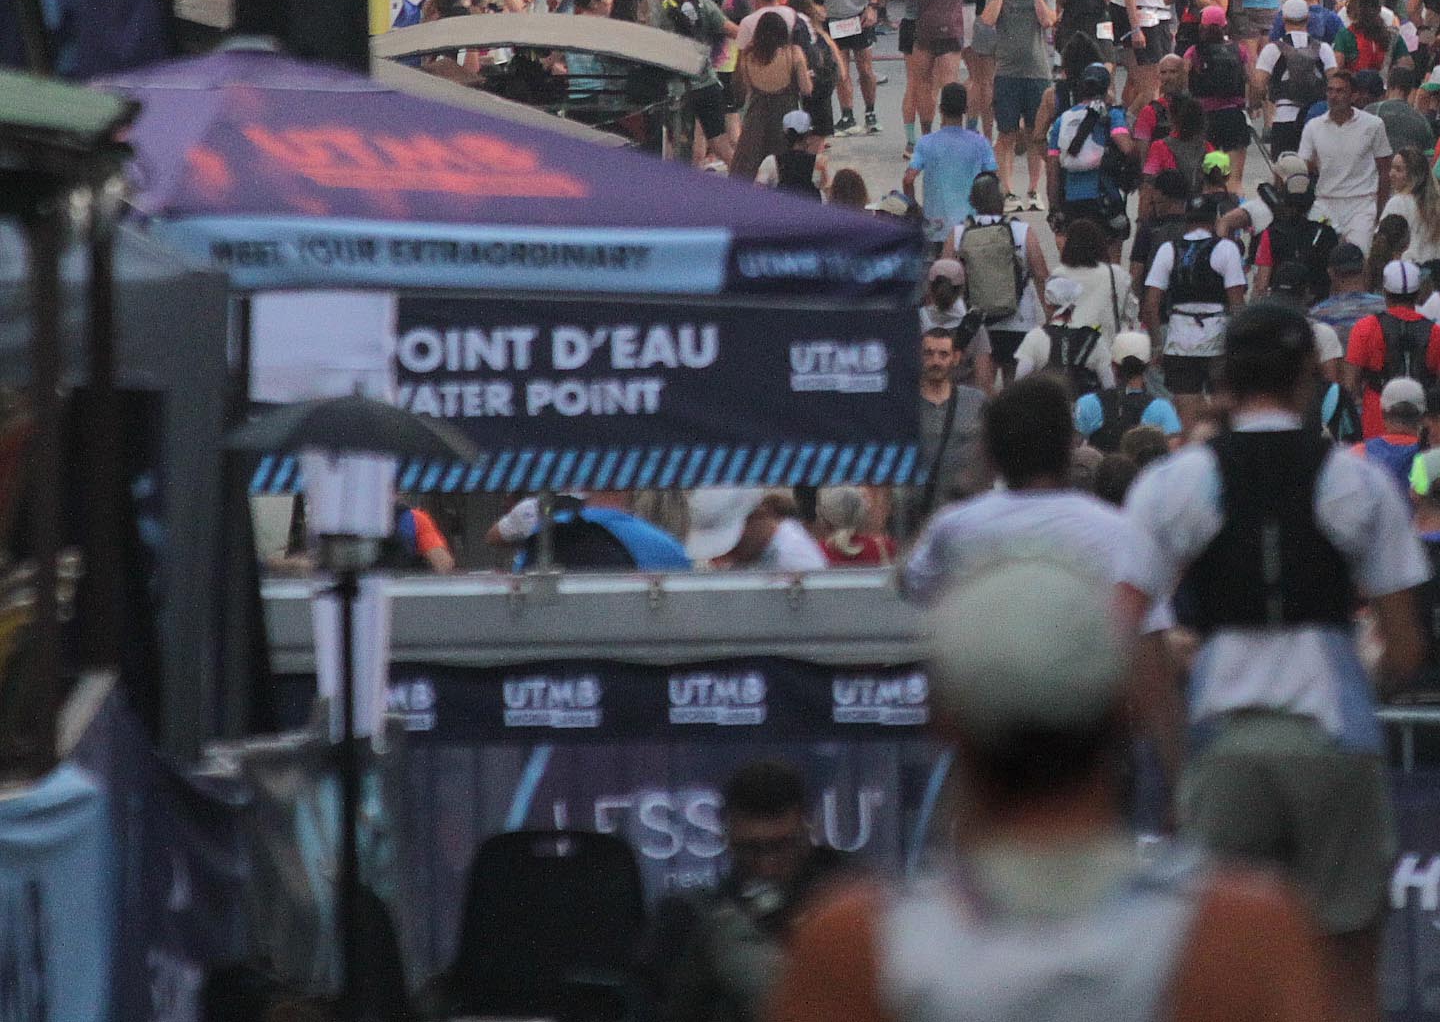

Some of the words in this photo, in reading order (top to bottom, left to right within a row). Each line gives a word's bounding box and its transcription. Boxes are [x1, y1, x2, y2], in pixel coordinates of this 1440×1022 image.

[390, 326, 539, 373] OINT
[551, 324, 721, 370] D'EAU
[789, 340, 889, 374] UTMB
[525, 379, 666, 416] POINT
[502, 678, 602, 710] UTMB
[667, 672, 767, 706] UTMB
[832, 674, 929, 706] UTMB
